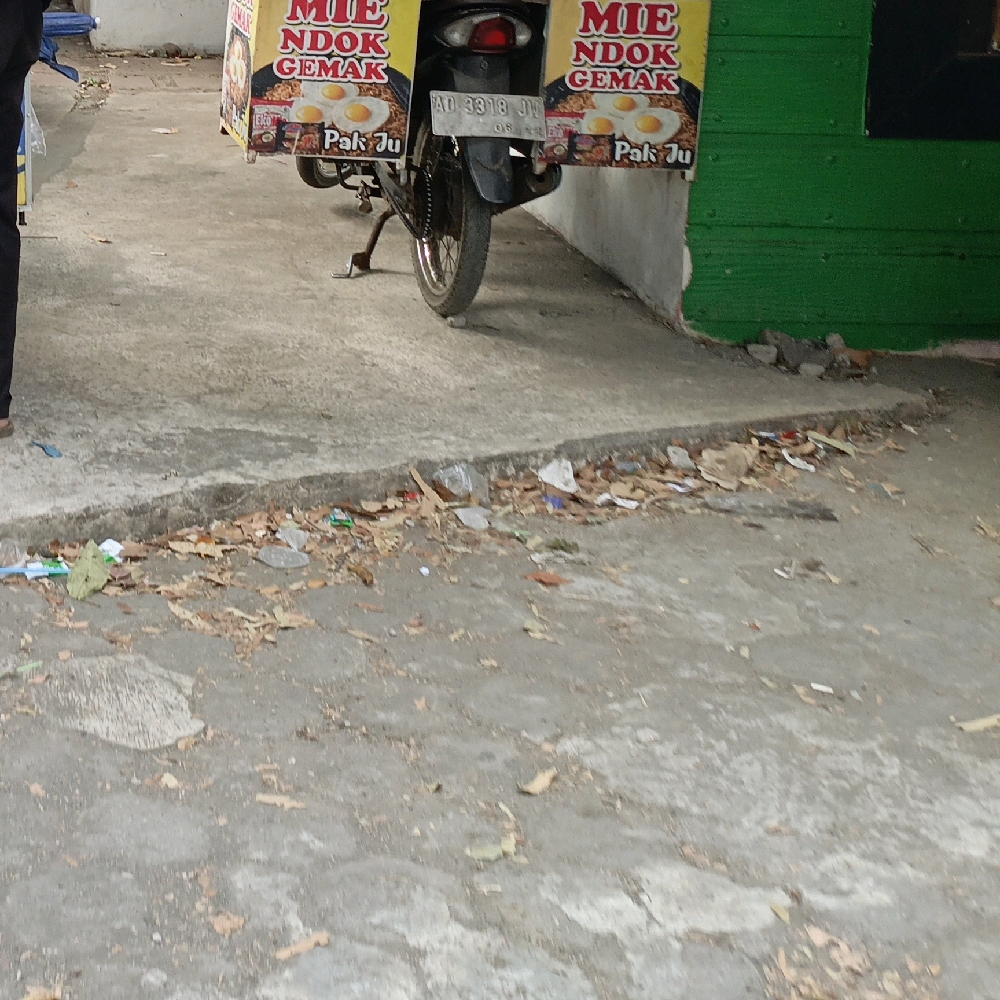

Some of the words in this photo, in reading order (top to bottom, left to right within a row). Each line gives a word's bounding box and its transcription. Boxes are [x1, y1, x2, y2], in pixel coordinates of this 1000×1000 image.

[578, 0, 677, 37] MIE
[279, 26, 388, 56] NDOK
[571, 39, 679, 67] NDOK
[275, 56, 387, 81] GEMAK
[567, 69, 678, 93] GEMAK
[323, 129, 367, 152] Pak
[374, 131, 402, 153] Ju
[614, 140, 657, 163] Pak
[663, 142, 692, 165] Ju
